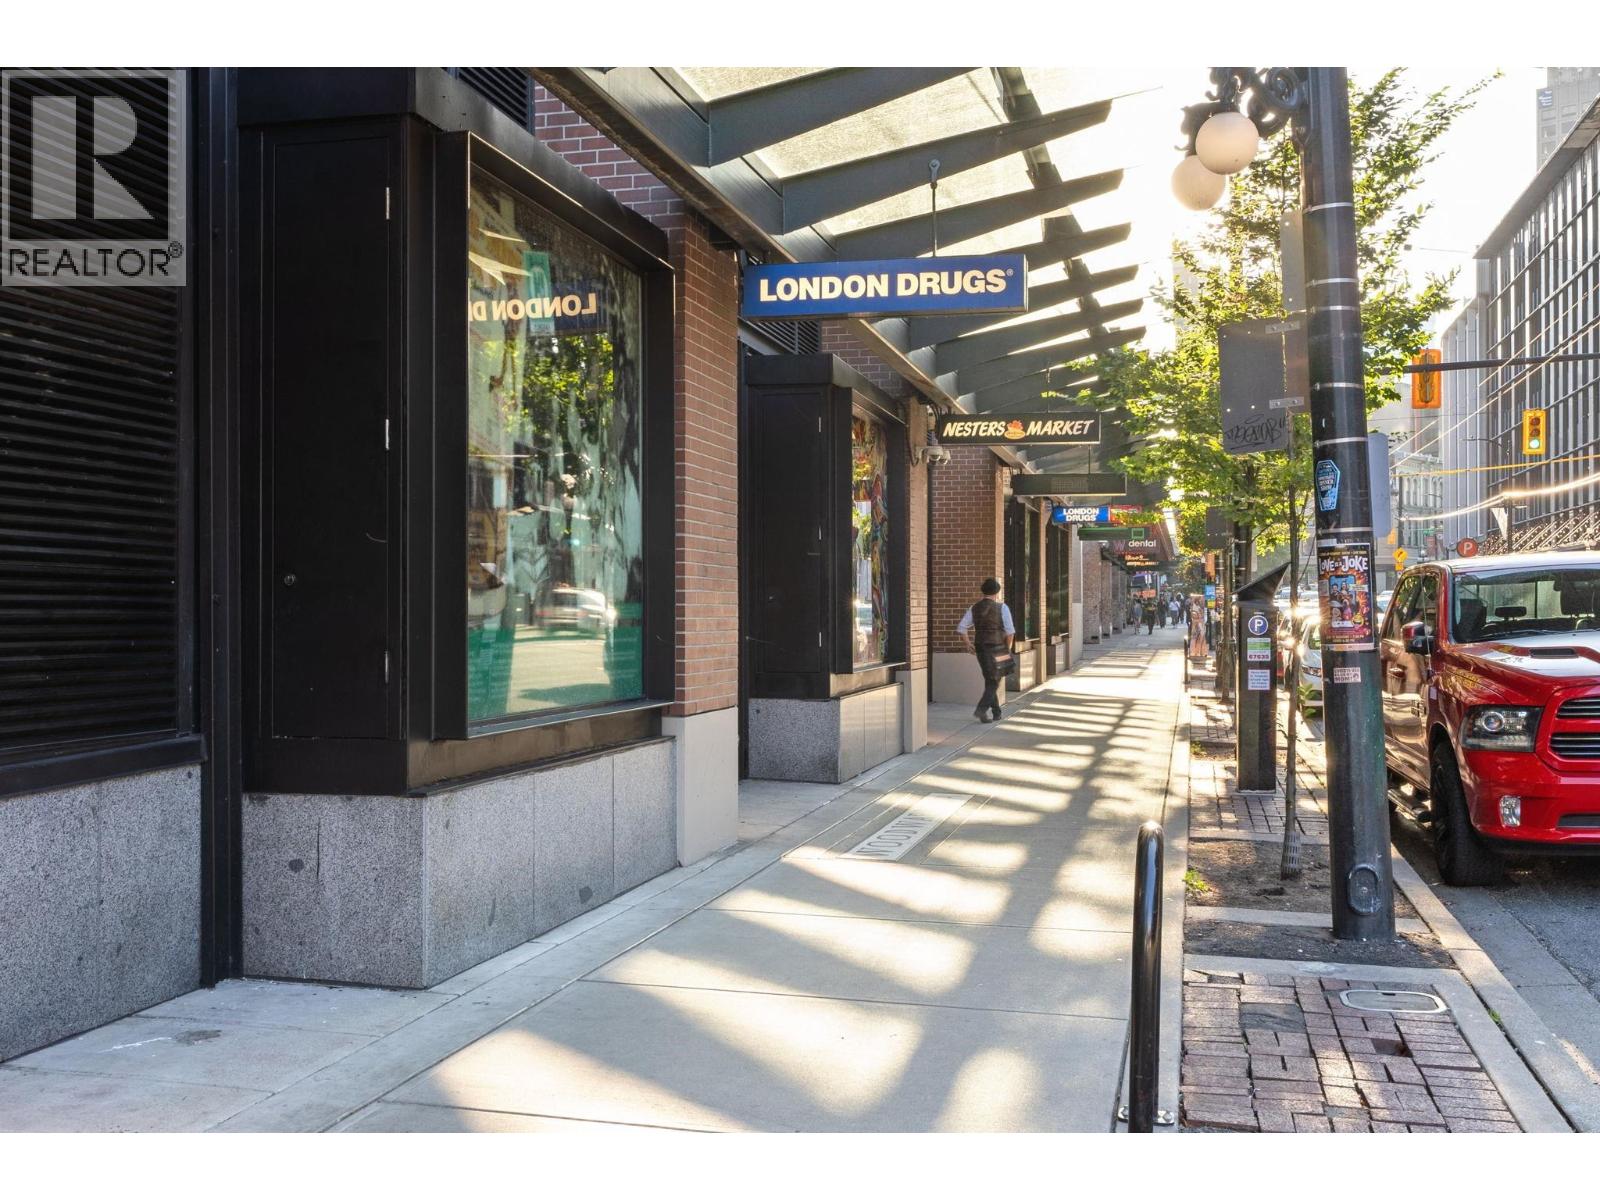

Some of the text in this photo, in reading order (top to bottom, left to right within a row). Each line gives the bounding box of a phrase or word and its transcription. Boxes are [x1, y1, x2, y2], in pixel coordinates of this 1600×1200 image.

[760, 273, 889, 302] LONDON
[942, 420, 1007, 437] NESTERS
[1026, 419, 1095, 436] MARKET
[1062, 507, 1100, 516] LONDON
[1065, 514, 1097, 522] DRUGS
[1128, 539, 1157, 548] dental
[1463, 541, 1473, 555] P
[1318, 557, 1336, 575] LOVE
[1341, 555, 1369, 573] JOKE
